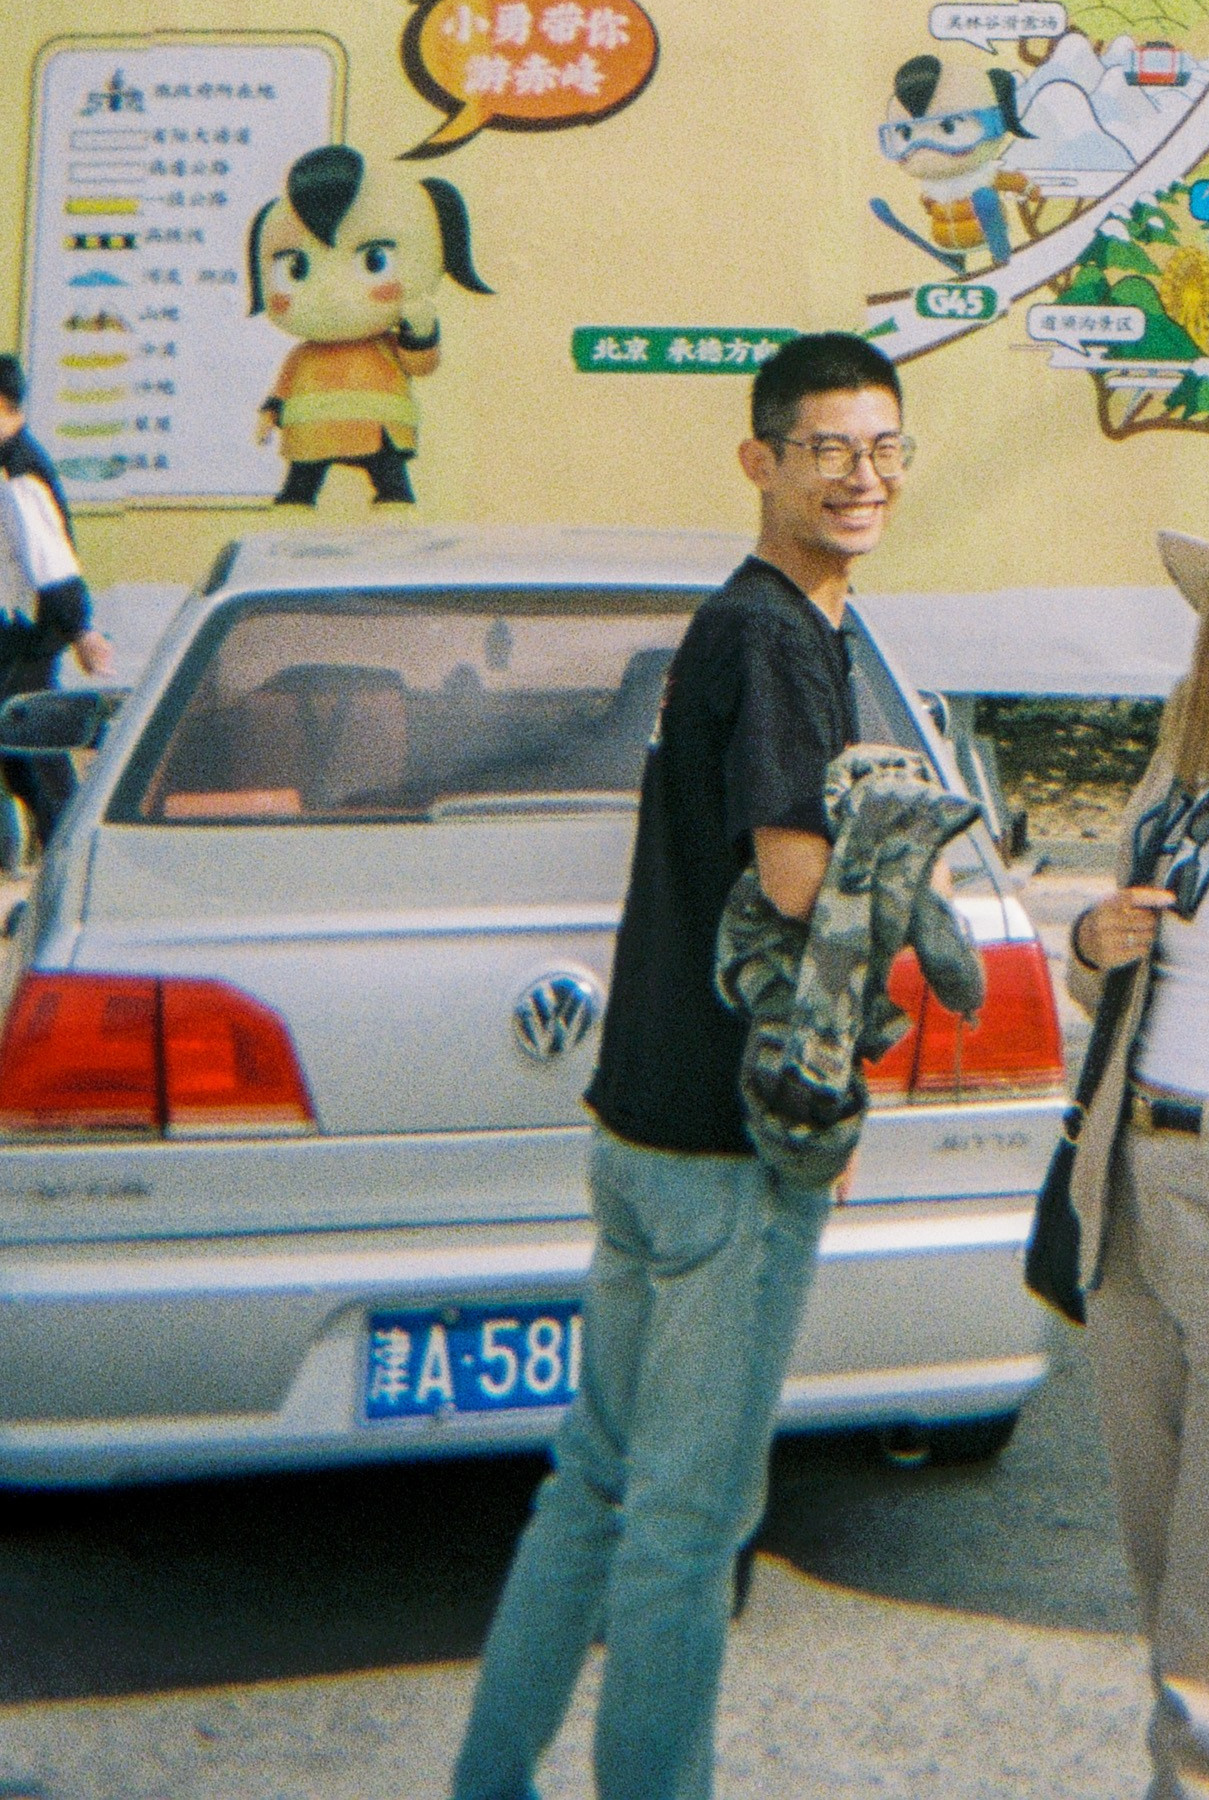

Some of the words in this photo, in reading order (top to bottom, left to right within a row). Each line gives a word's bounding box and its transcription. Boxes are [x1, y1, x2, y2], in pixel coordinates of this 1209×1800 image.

[441, 2, 631, 50] 小勇带你
[945, 12, 1058, 31] 美林谷滑雪场
[463, 55, 607, 96] 游赤峰
[926, 287, 985, 317] G45
[592, 335, 650, 362] 北京
